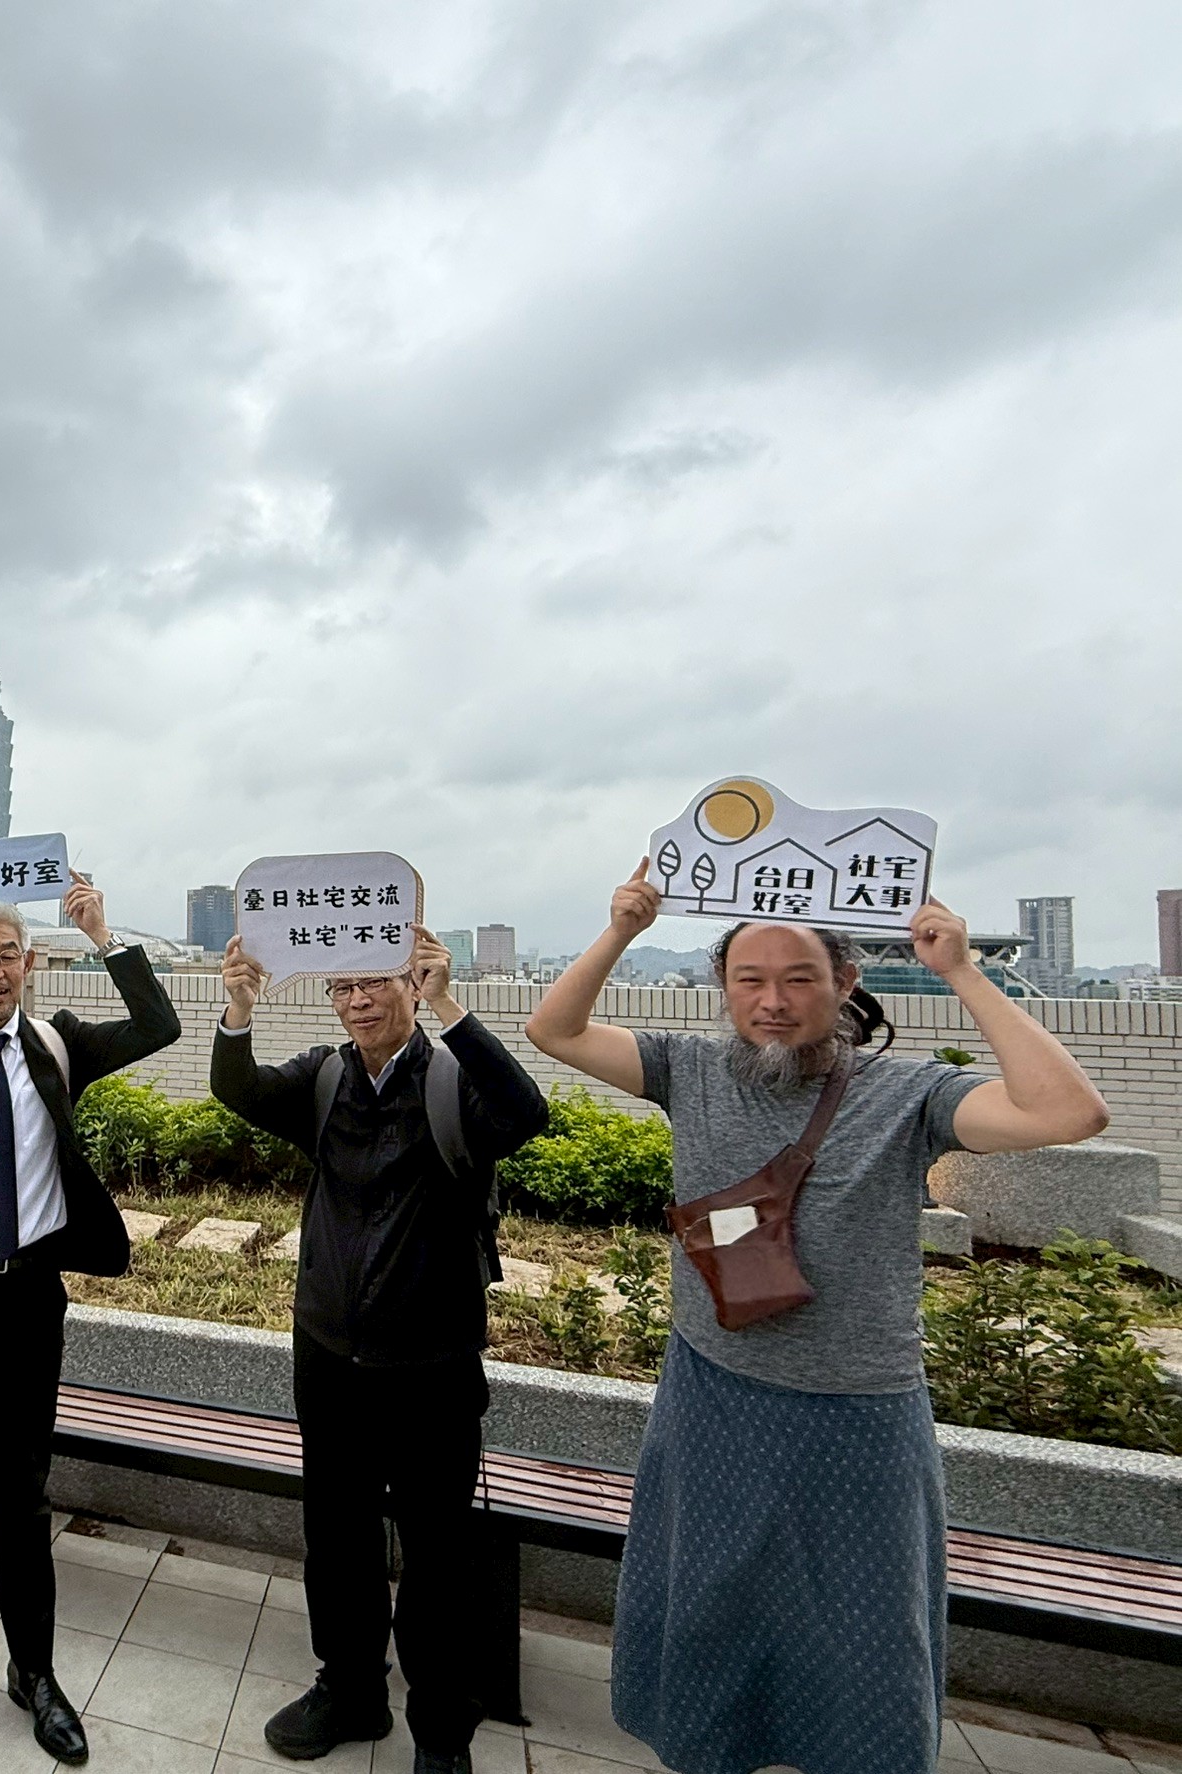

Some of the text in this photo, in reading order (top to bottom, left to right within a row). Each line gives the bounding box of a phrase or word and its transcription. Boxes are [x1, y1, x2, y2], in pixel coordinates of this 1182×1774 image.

[754, 866, 814, 889] 台日
[848, 854, 917, 880] 社宅
[244, 884, 400, 911] 臺日社宅交流
[752, 891, 813, 915] 好室
[845, 883, 913, 908] 大事
